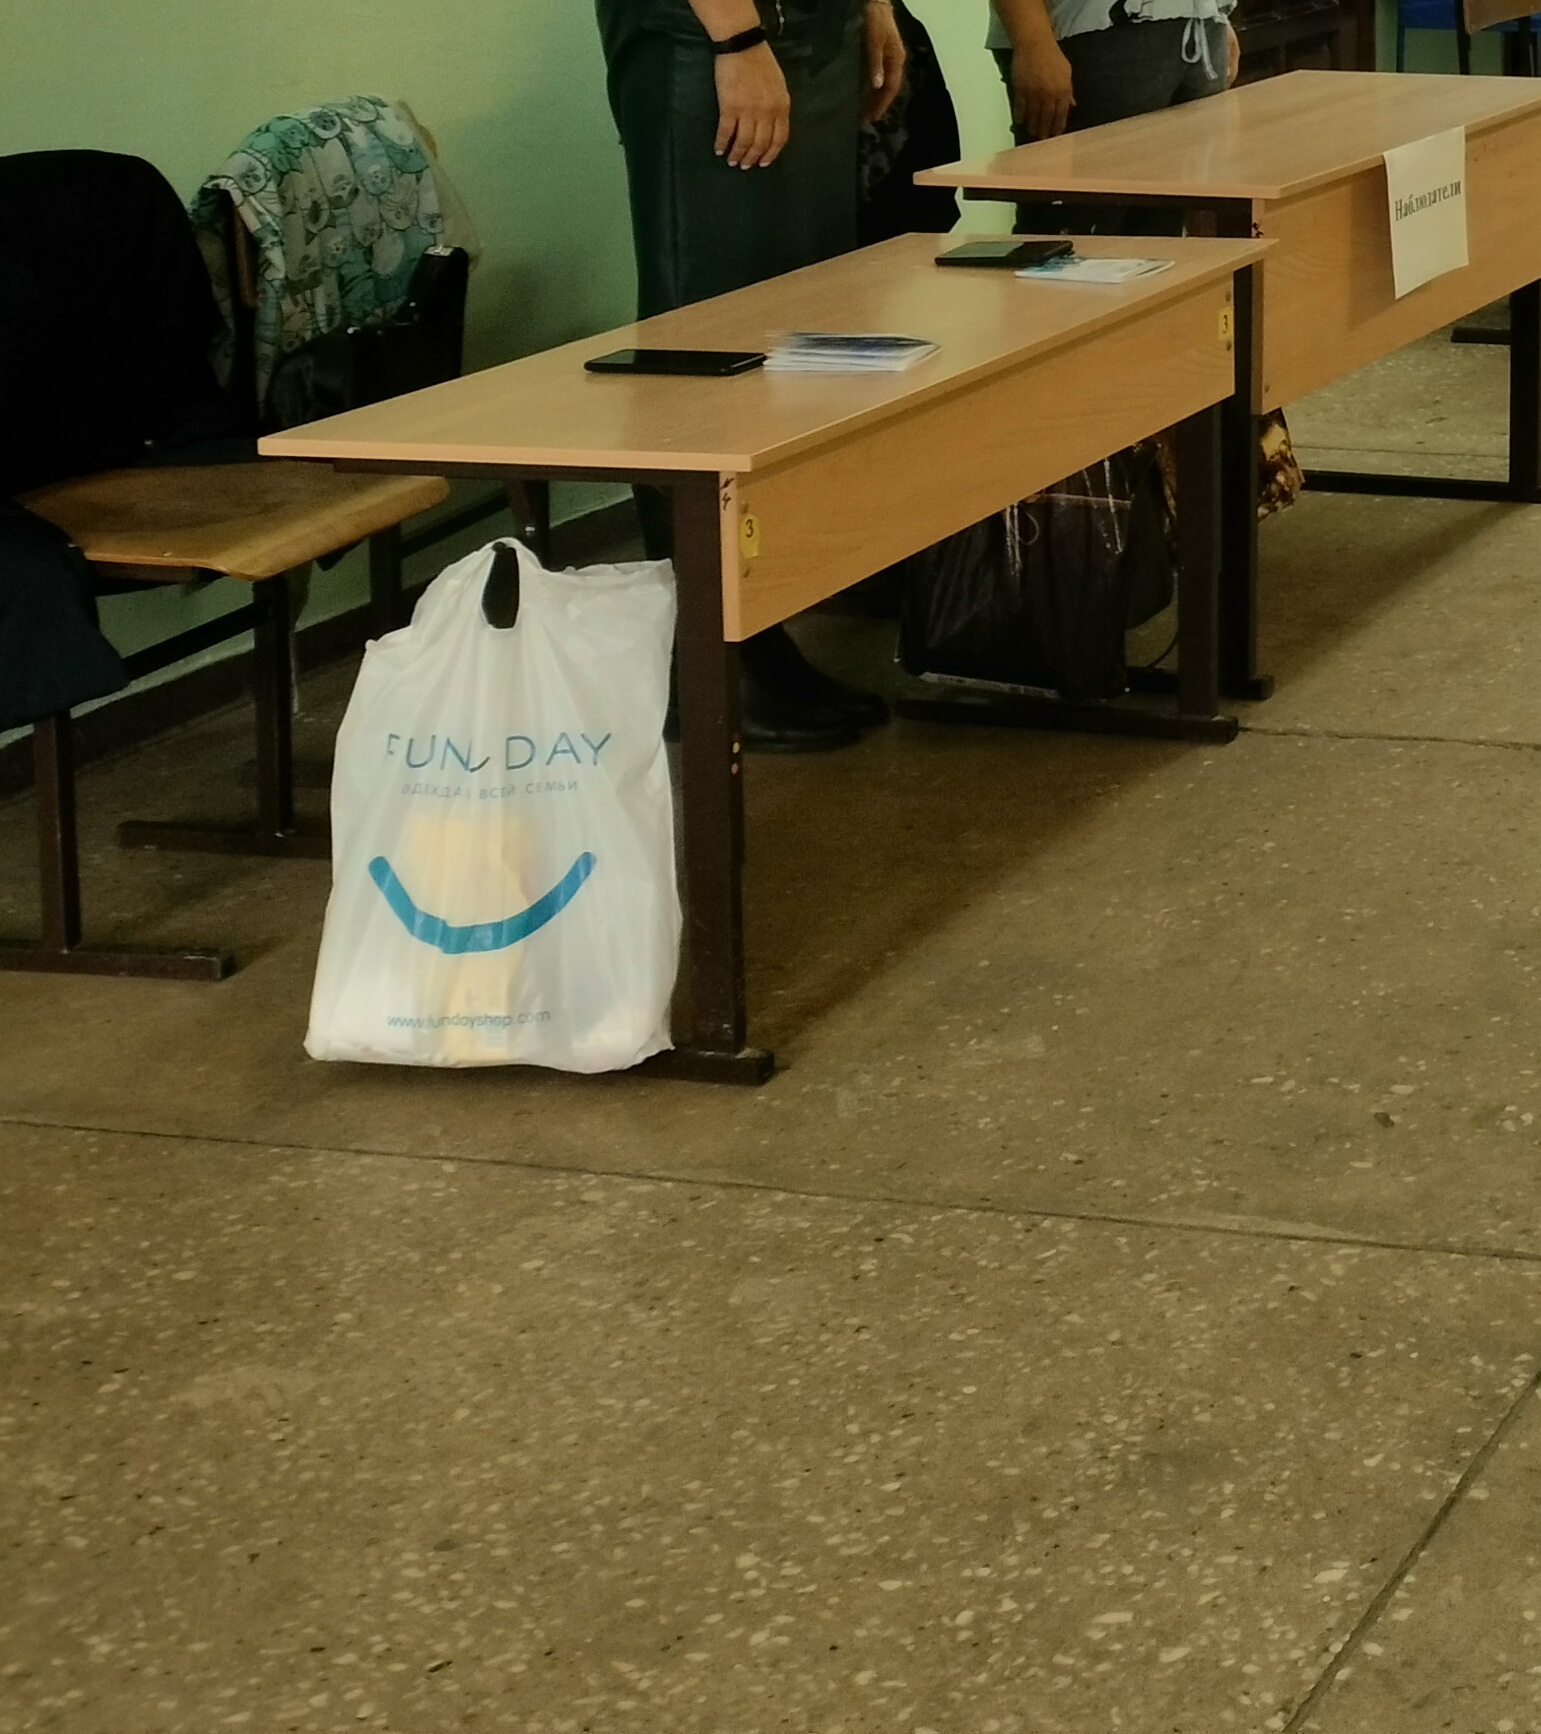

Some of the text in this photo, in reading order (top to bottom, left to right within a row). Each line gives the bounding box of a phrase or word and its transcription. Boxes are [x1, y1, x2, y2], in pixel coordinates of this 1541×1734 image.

[1395, 180, 1461, 221] Наблюдатели
[745, 518, 754, 539] 3
[505, 732, 612, 770] DAY
[525, 780, 579, 795] СЕМЬИ
